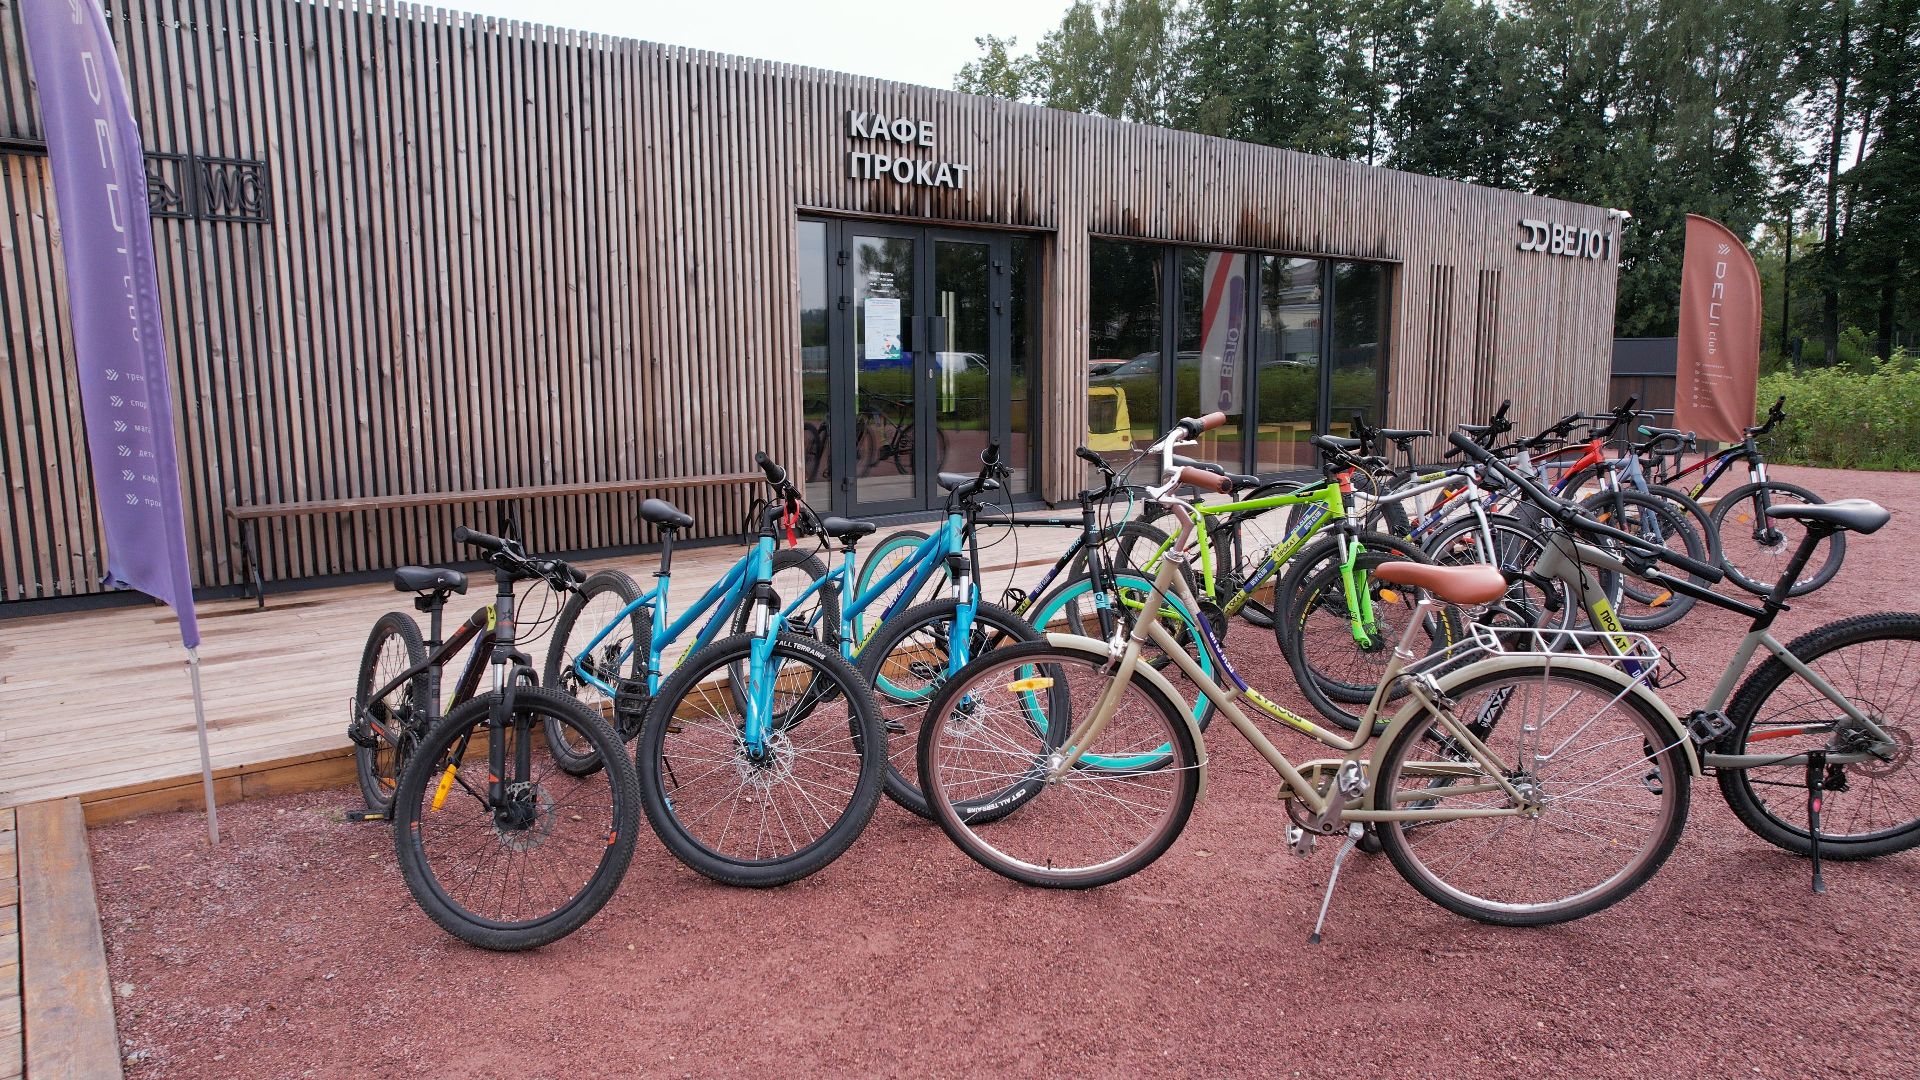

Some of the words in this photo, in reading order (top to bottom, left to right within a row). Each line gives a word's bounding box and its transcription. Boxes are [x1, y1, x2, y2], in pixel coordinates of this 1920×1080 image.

[848, 110, 935, 147] КАФЕ
[849, 151, 970, 189] ПРОКАТ
[200, 166, 265, 212] WC
[1550, 223, 1604, 260] ВЕЛО
[1277, 537, 1297, 559] ПРОКАТ
[778, 639, 793, 649] ALL
[793, 642, 826, 661] TERRAINS
[999, 797, 1012, 807] ALL
[1011, 788, 1027, 802] CST
[966, 803, 1000, 814] TERRAINS
